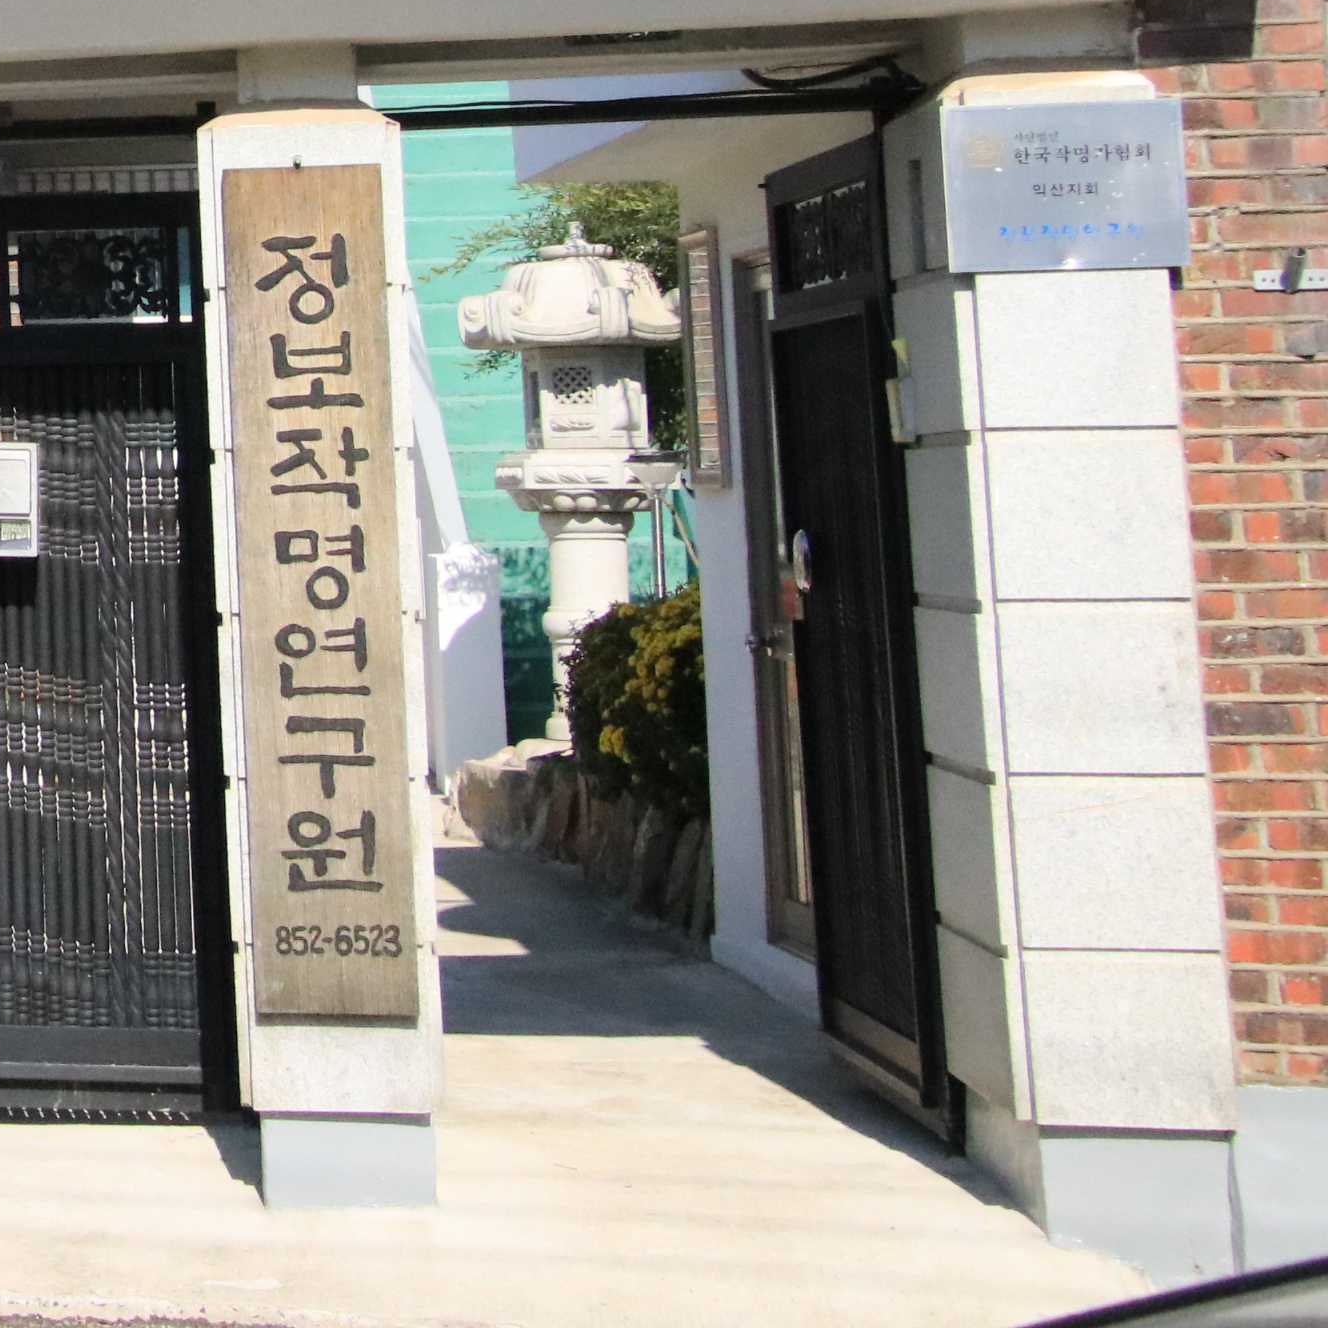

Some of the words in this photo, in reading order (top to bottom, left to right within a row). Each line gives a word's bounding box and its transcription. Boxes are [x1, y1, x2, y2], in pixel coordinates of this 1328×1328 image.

[1013, 142, 1151, 165] 한국작명가협회
[1032, 182, 1099, 197] 익산지회
[253, 231, 385, 895] 정보작명연구원
[275, 924, 403, 958] 852-6523
